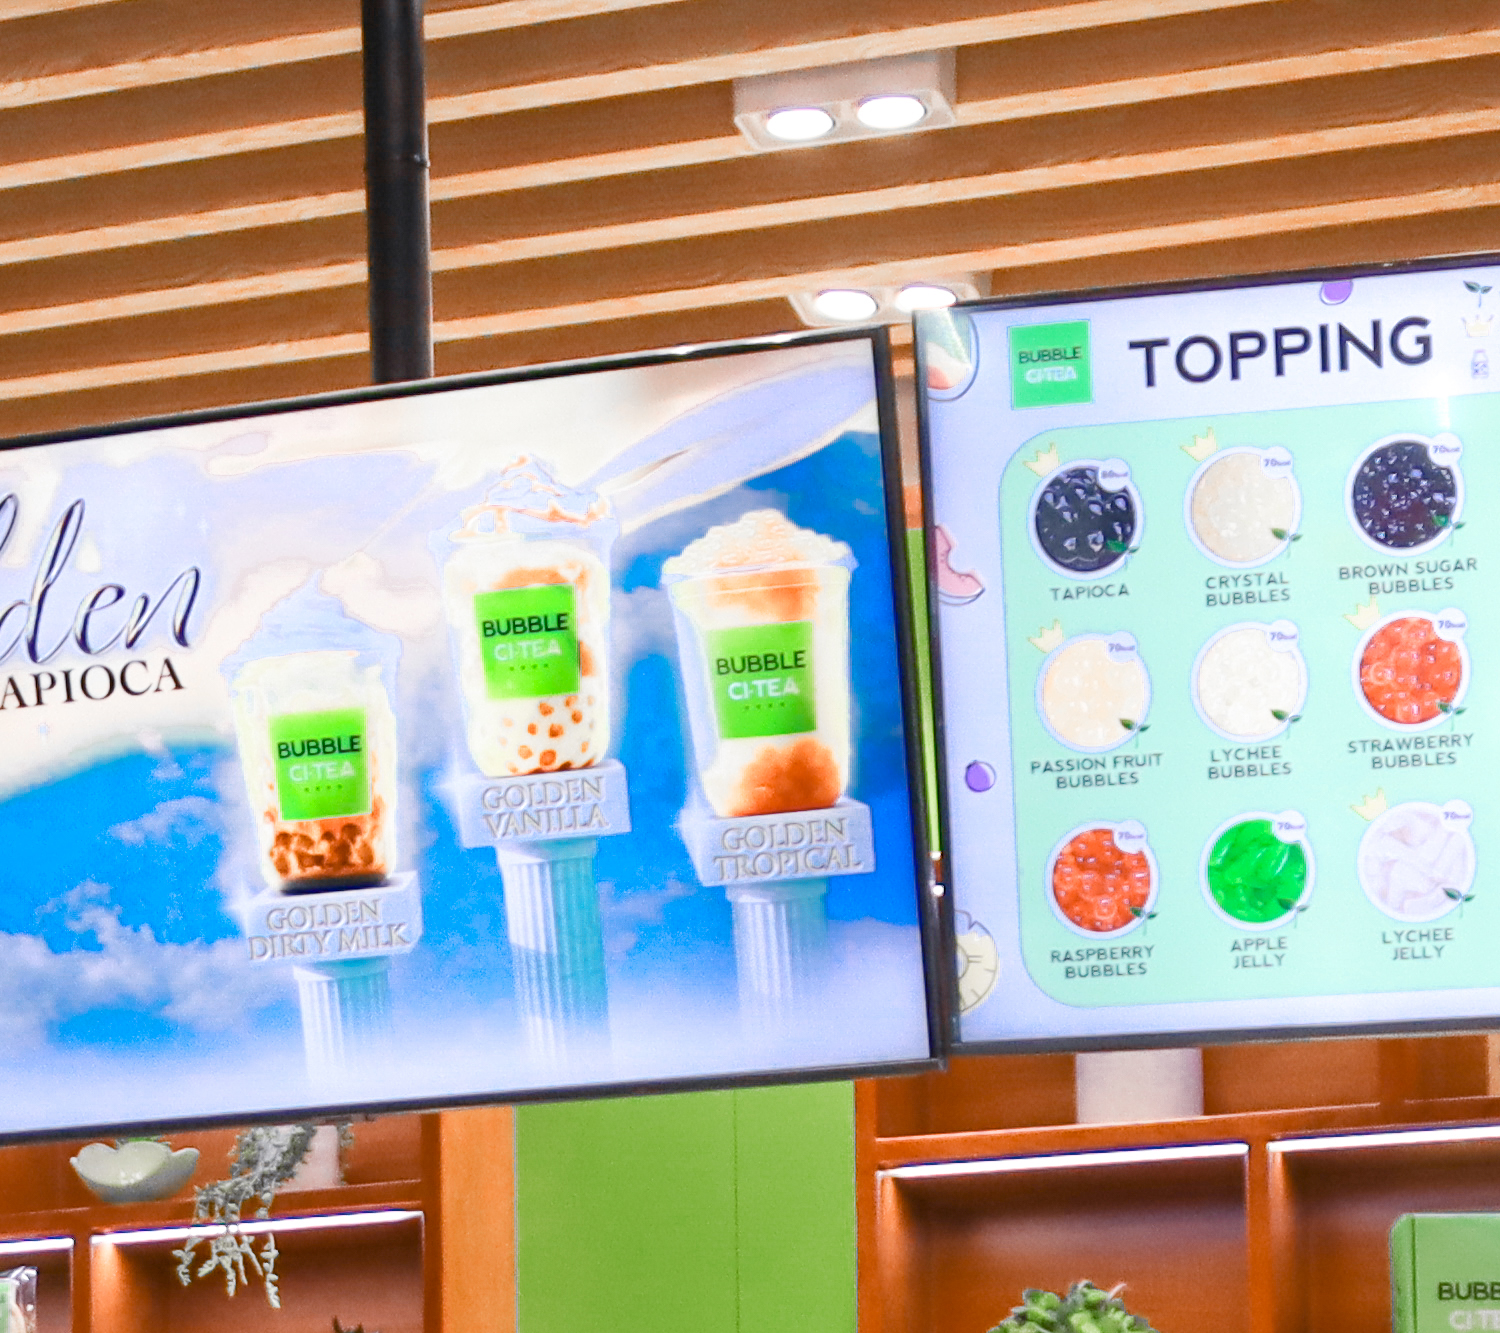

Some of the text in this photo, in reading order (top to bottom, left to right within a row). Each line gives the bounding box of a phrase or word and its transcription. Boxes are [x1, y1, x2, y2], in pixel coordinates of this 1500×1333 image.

[1018, 346, 1082, 364] BUBBLE
[1128, 316, 1433, 388] TOPPING
[1205, 571, 1290, 589] CRYSTAL
[1339, 557, 1478, 580] BROWN SUGAR
[1050, 583, 1130, 600] TAPIOCA
[1206, 589, 1291, 606] BUBBLES
[1368, 576, 1454, 595] BUBBLES
[716, 650, 806, 676] BUBBLE
[482, 776, 603, 812] GOLDEN
[483, 805, 610, 837] VANILLA
[721, 818, 848, 850] GOLDEN
[713, 844, 861, 881] TROPICAL
[266, 899, 382, 931] GOLDEN
[249, 923, 411, 962] DIRTY MILK
